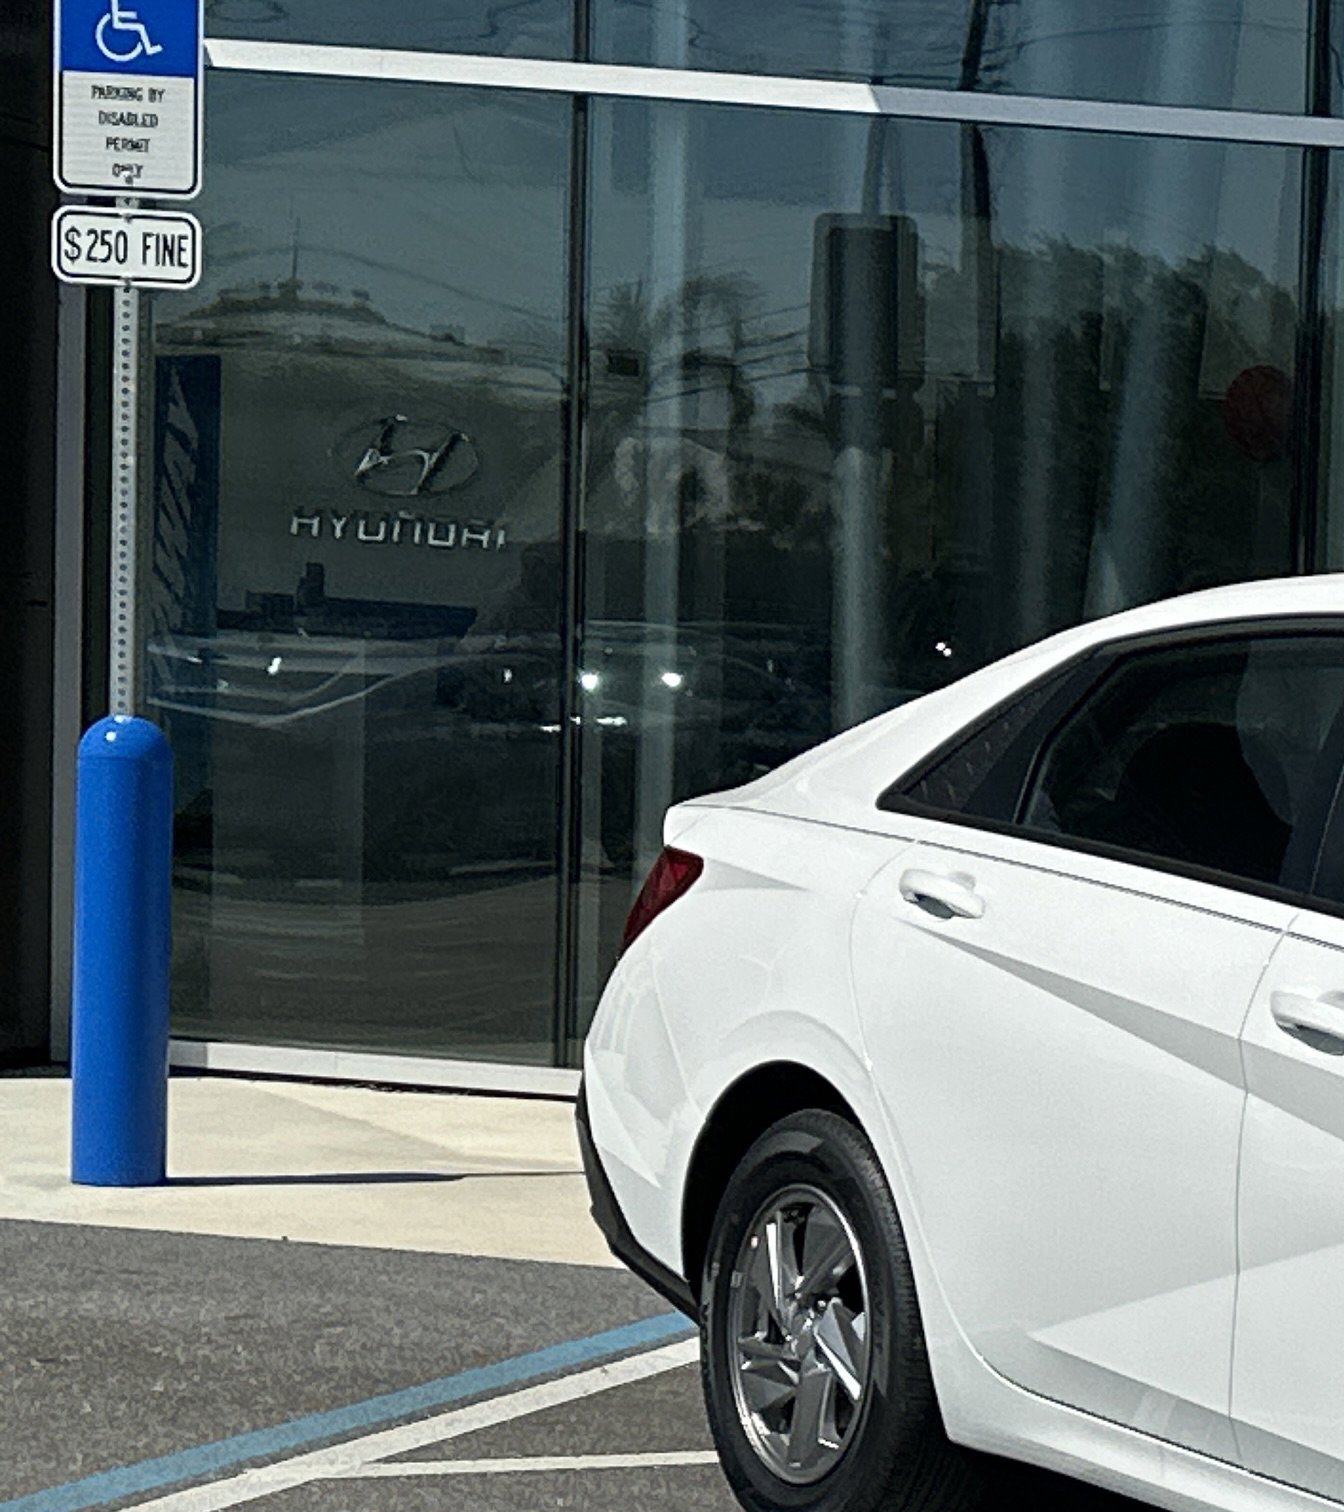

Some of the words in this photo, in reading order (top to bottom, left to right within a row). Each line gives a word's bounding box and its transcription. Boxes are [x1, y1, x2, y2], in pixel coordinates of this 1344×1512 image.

[91, 84, 143, 102] PARKING
[148, 88, 166, 103] BY
[98, 110, 159, 128] DISABLED
[63, 226, 128, 264] $250
[141, 231, 189, 267] FINE
[289, 508, 505, 550] HYUNDAI
